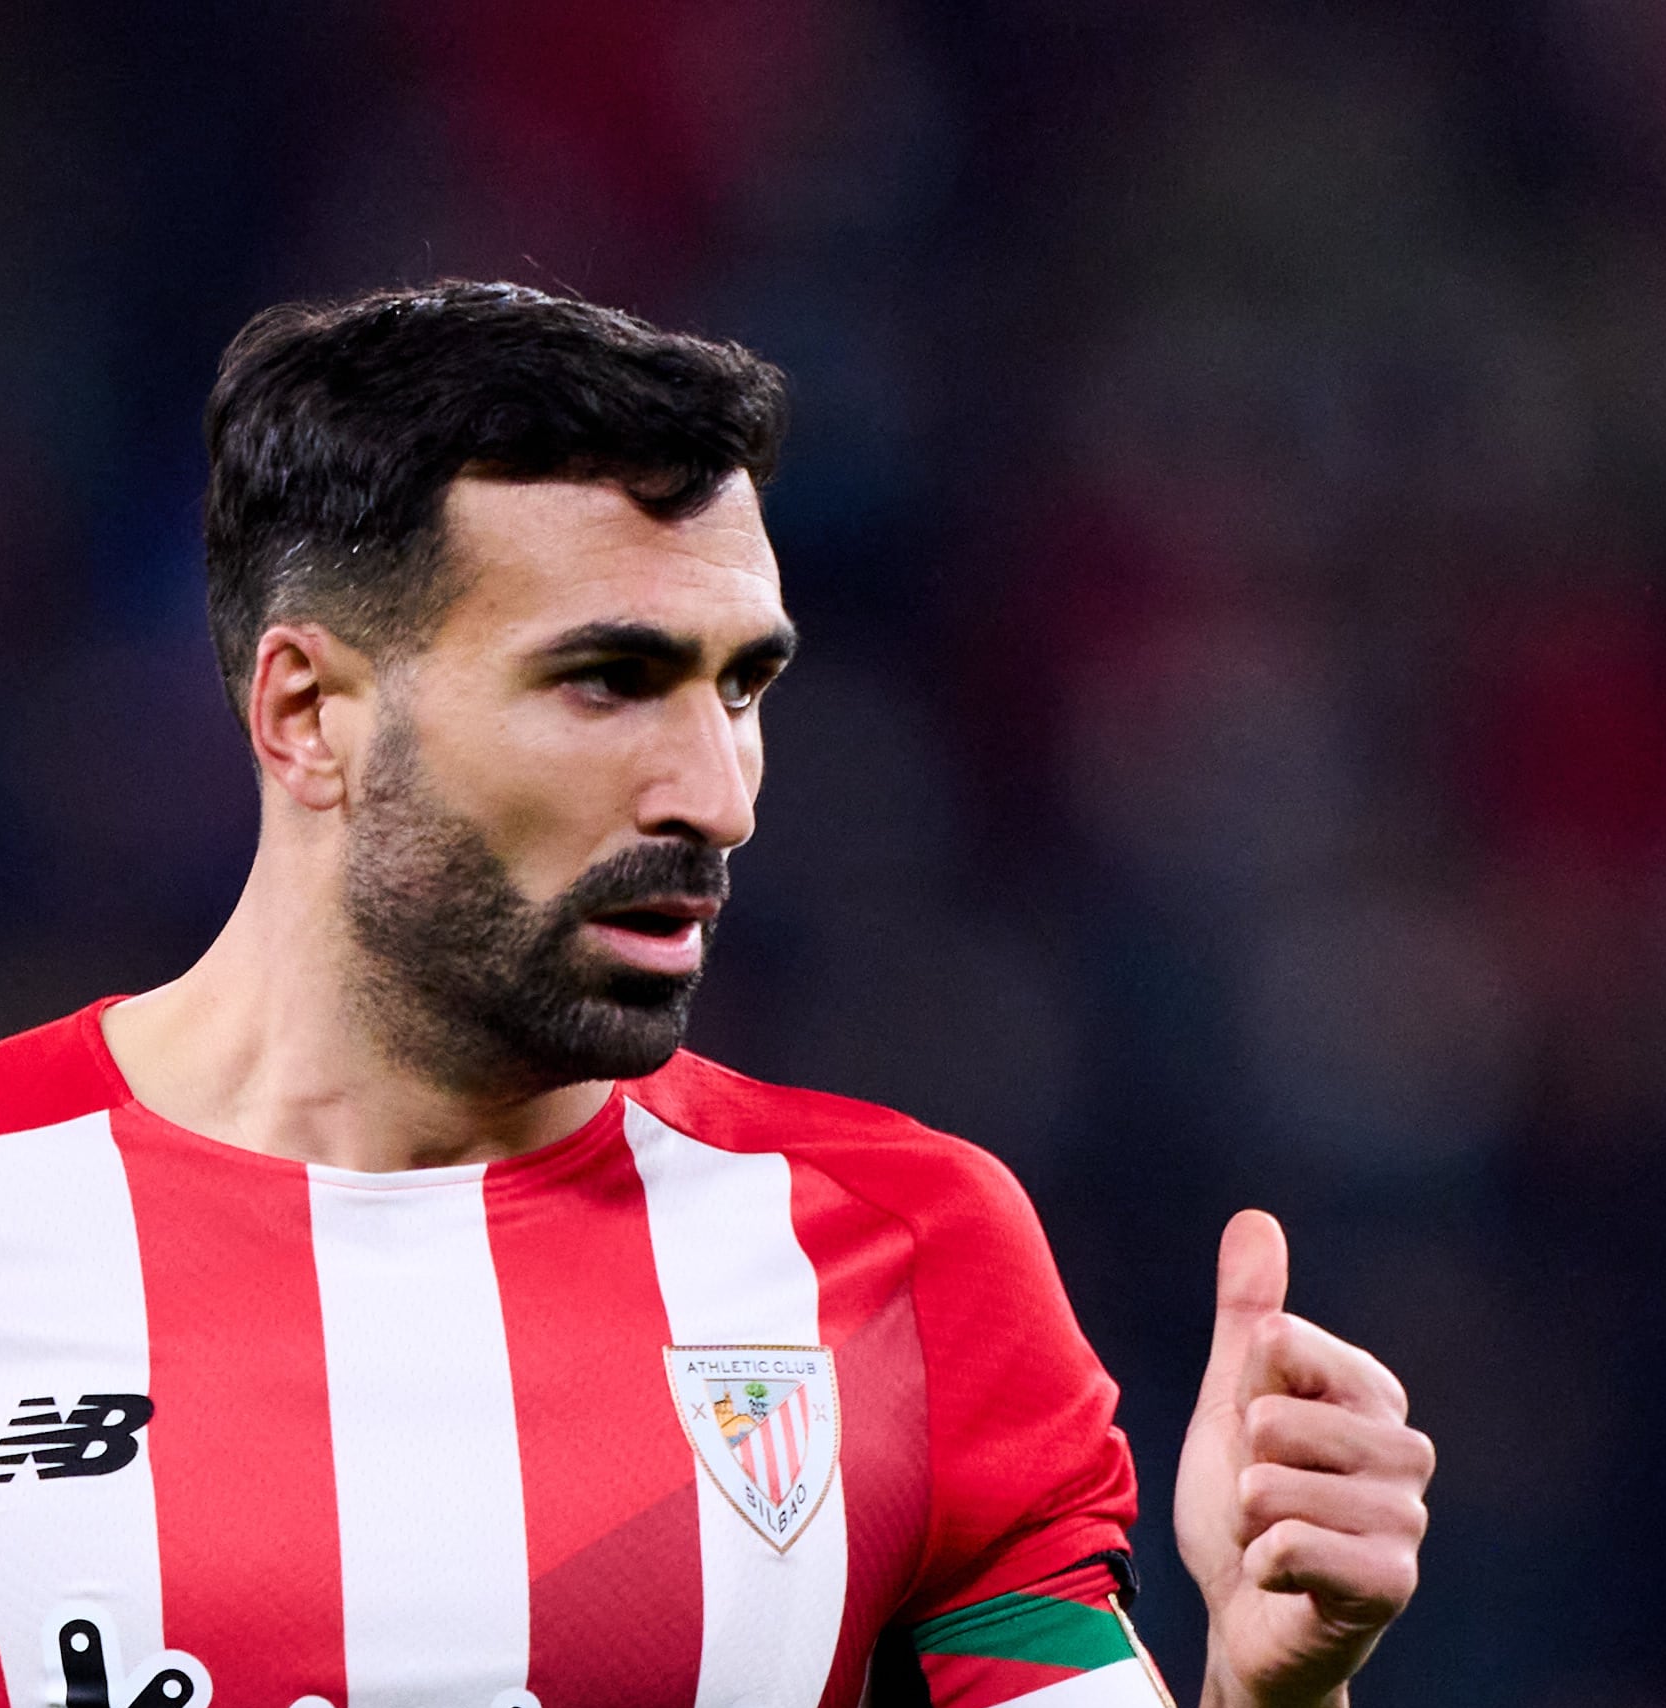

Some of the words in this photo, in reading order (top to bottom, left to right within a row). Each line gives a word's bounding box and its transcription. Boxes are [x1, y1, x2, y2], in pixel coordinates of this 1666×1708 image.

[687, 1360, 769, 1374] ATHLETIC
[776, 1361, 817, 1375] CLUB
[744, 1483, 807, 1534] BILBAO
